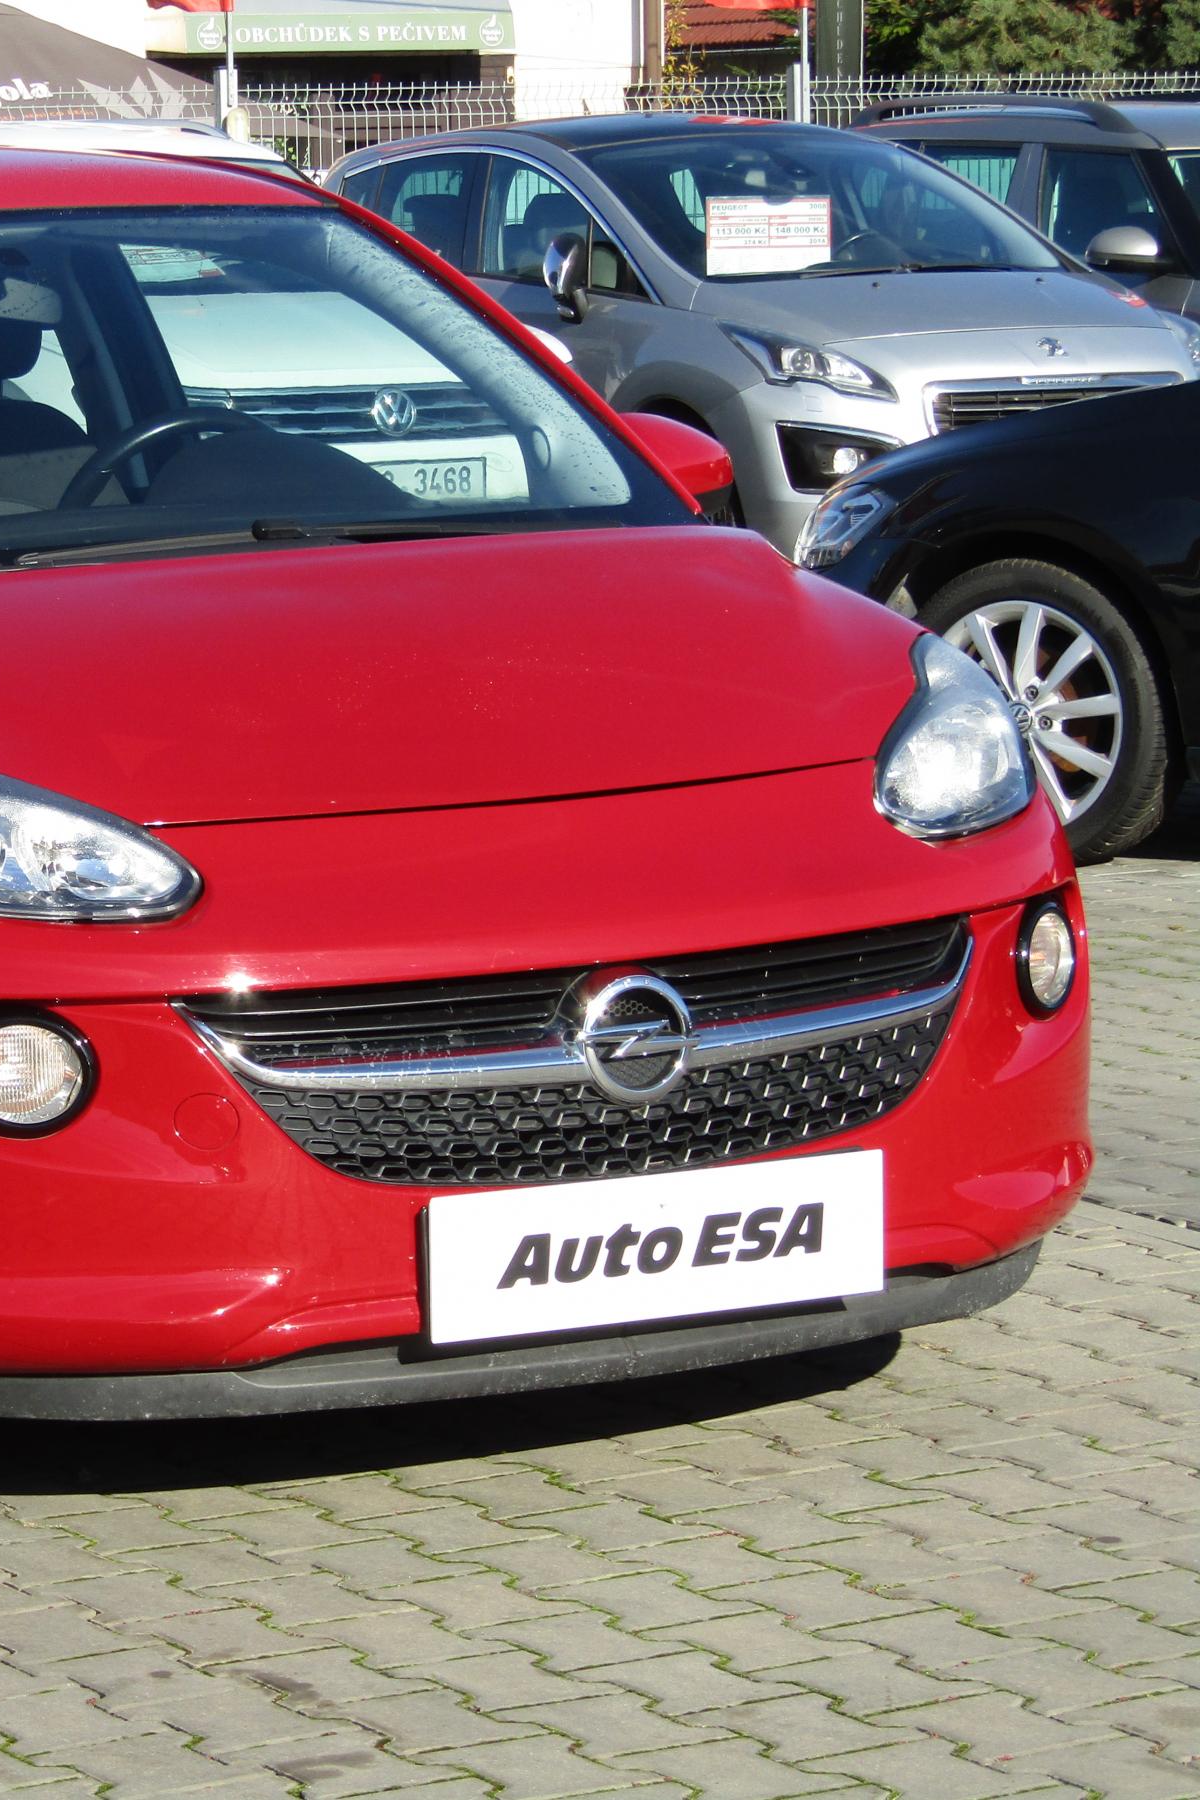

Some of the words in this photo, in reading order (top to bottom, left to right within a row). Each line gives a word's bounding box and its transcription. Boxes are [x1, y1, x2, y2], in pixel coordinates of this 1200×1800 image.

[235, 22, 353, 43] OBCHŮDEK
[358, 26, 370, 42] S
[376, 22, 466, 42] PEČIVEM
[414, 465, 471, 495] 3468
[496, 1223, 684, 1290] Auto
[691, 1202, 825, 1268] ESA
